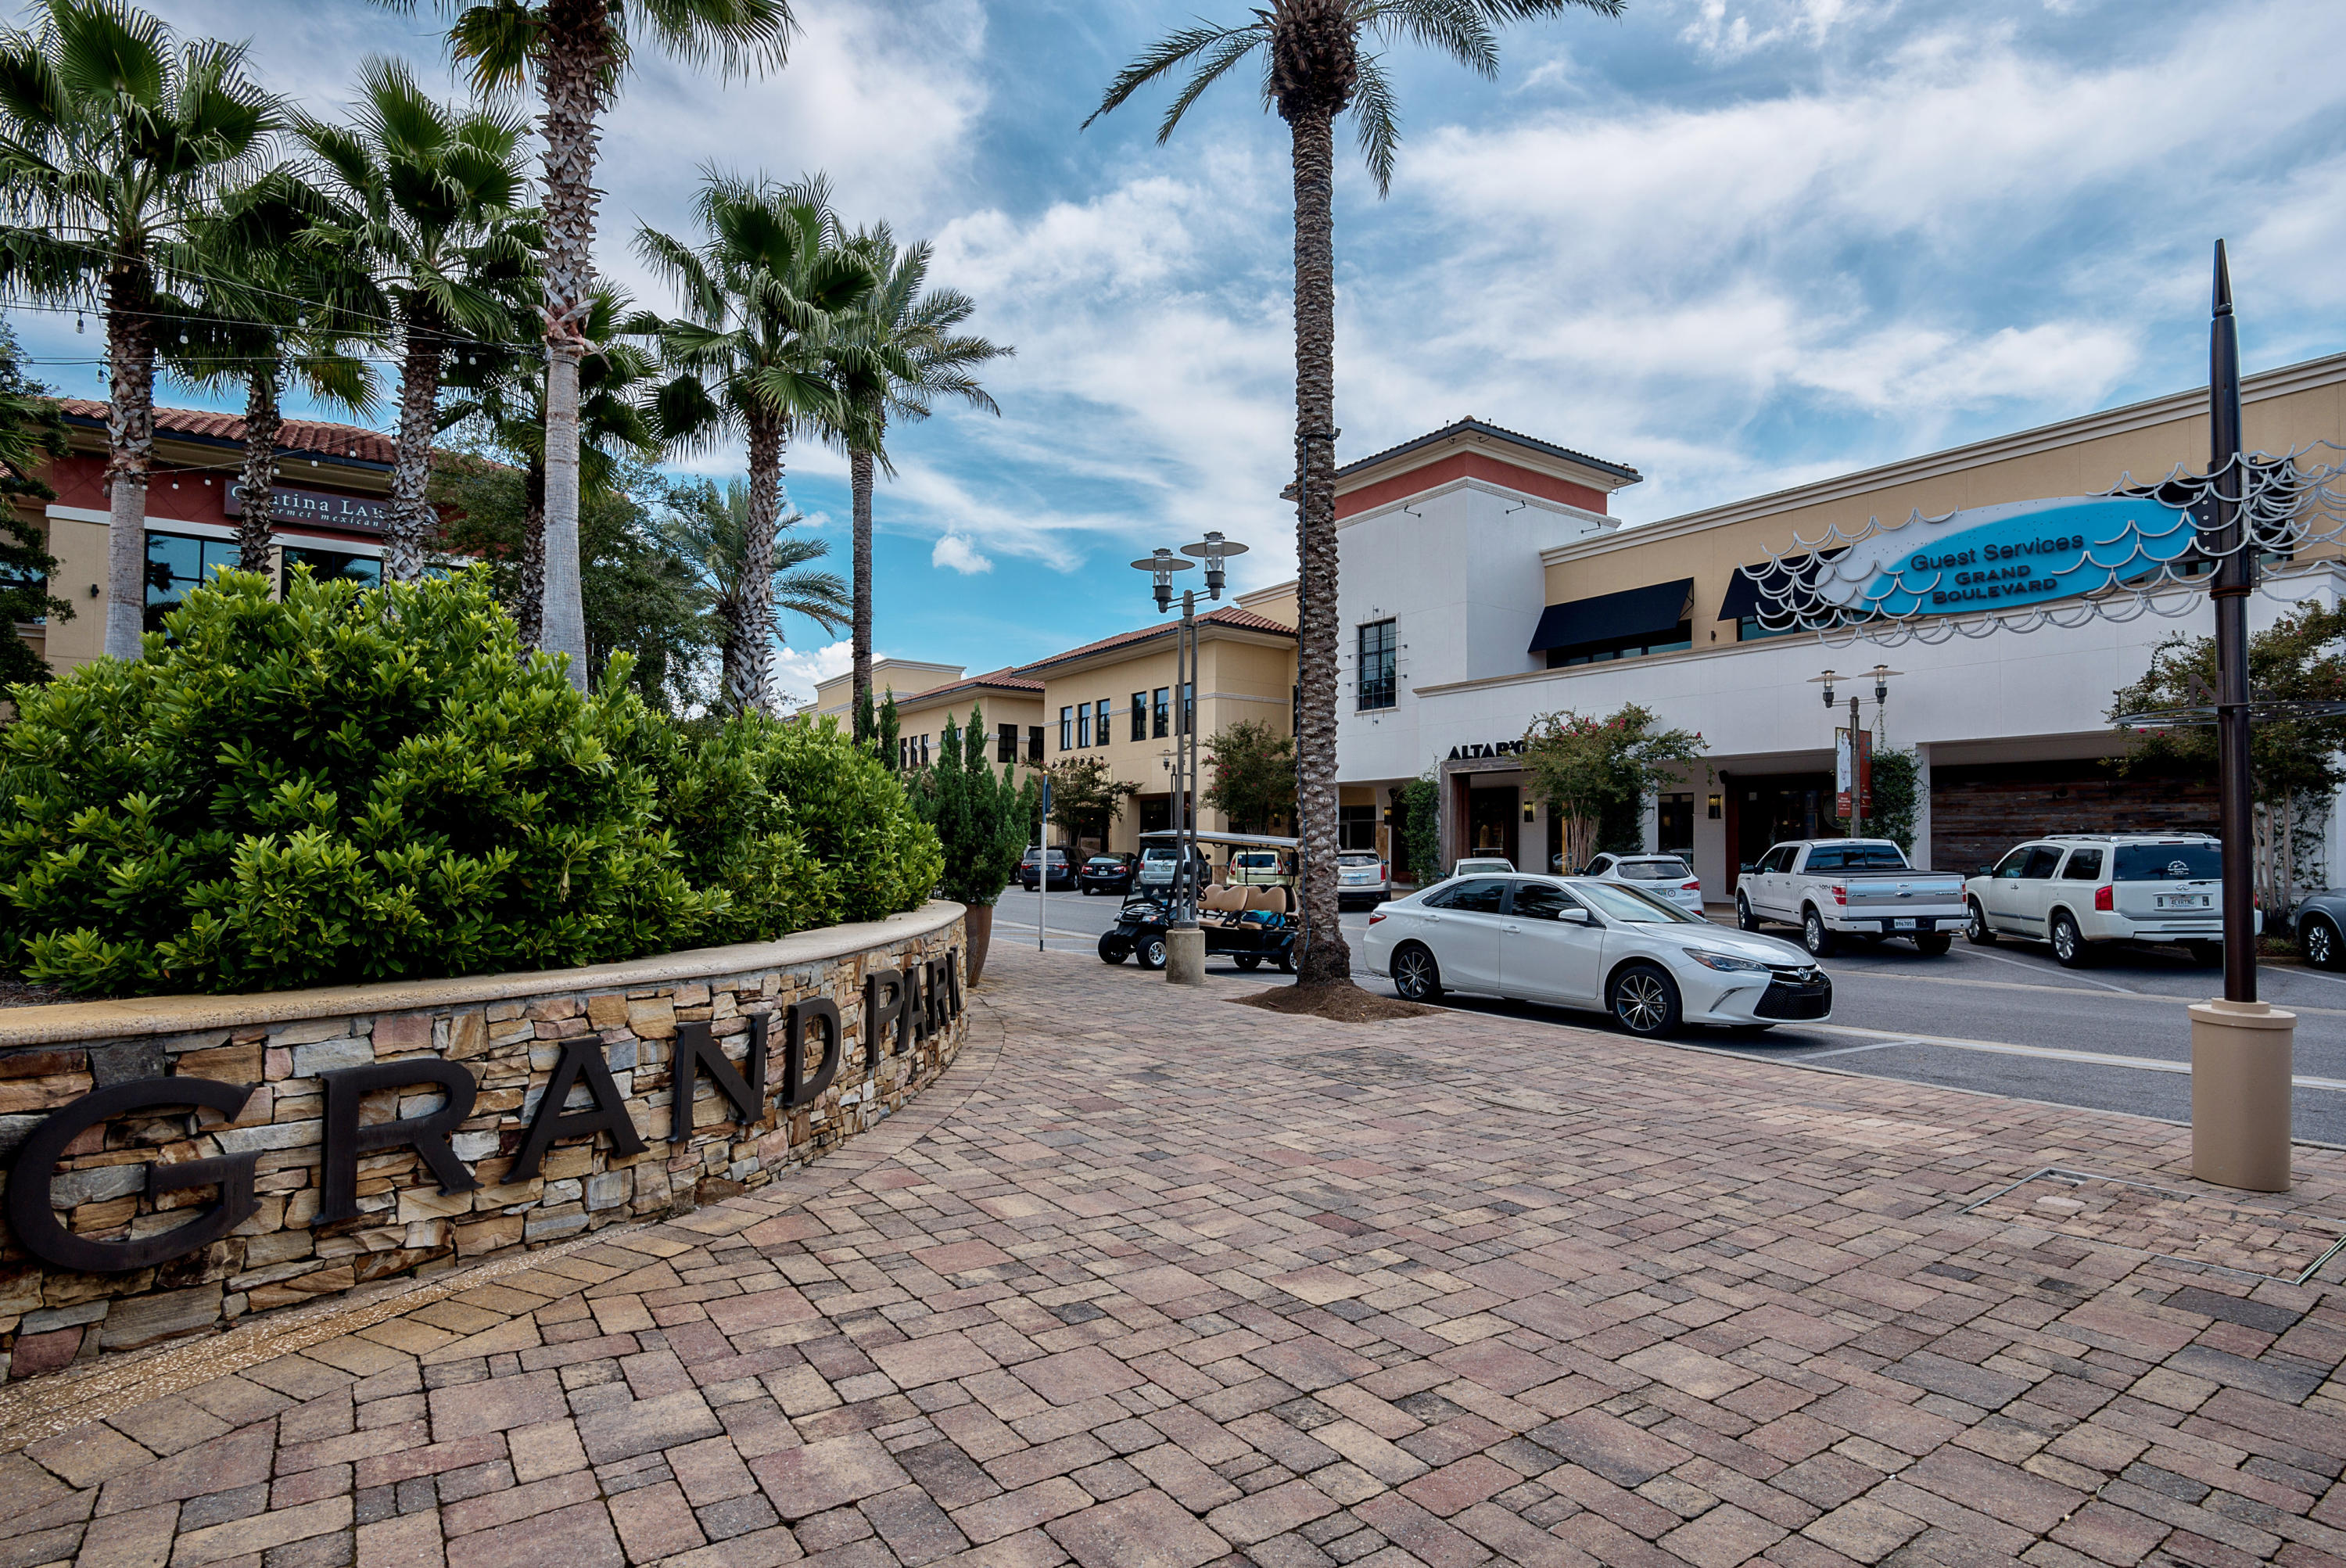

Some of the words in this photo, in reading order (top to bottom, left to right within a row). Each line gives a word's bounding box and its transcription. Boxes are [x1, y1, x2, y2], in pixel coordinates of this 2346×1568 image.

[321, 514, 378, 526] mexican
[1910, 547, 1976, 571] Guest
[1983, 535, 2084, 561] Services
[1955, 565, 2031, 585] GRAND
[1932, 578, 2057, 604] BOULEVARD
[8, 998, 841, 1272] GRAND
[864, 945, 961, 1068] PARK
